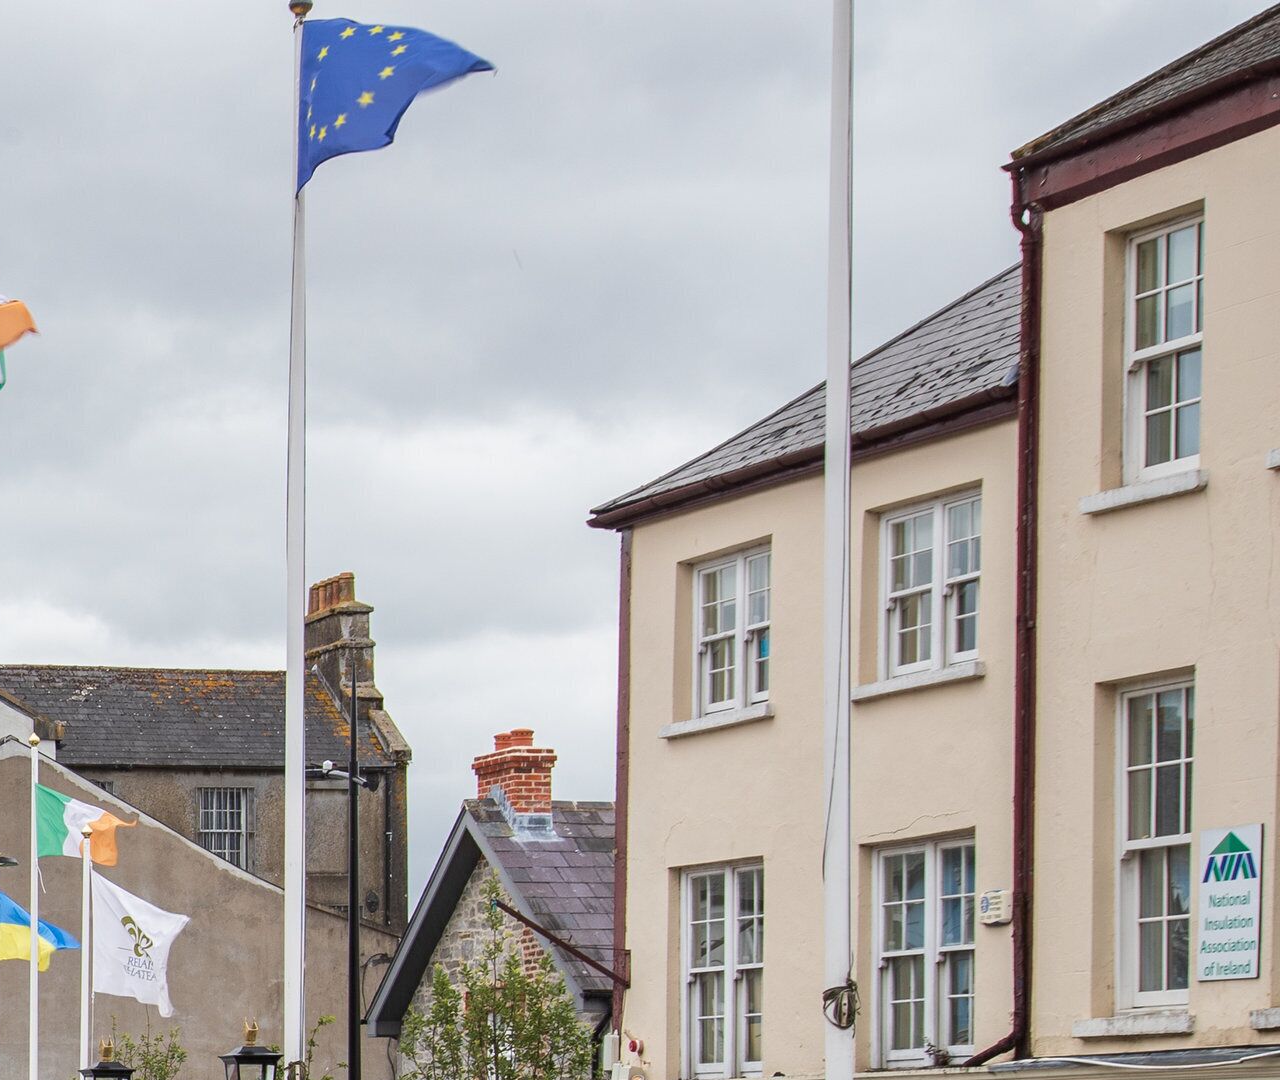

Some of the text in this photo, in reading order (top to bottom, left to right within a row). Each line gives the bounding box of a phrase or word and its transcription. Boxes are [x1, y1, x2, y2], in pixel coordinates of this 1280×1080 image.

[1208, 891, 1251, 908] National
[1204, 914, 1254, 931] Insulation
[1200, 937, 1257, 954] Association
[1203, 959, 1252, 976] of Ireland
